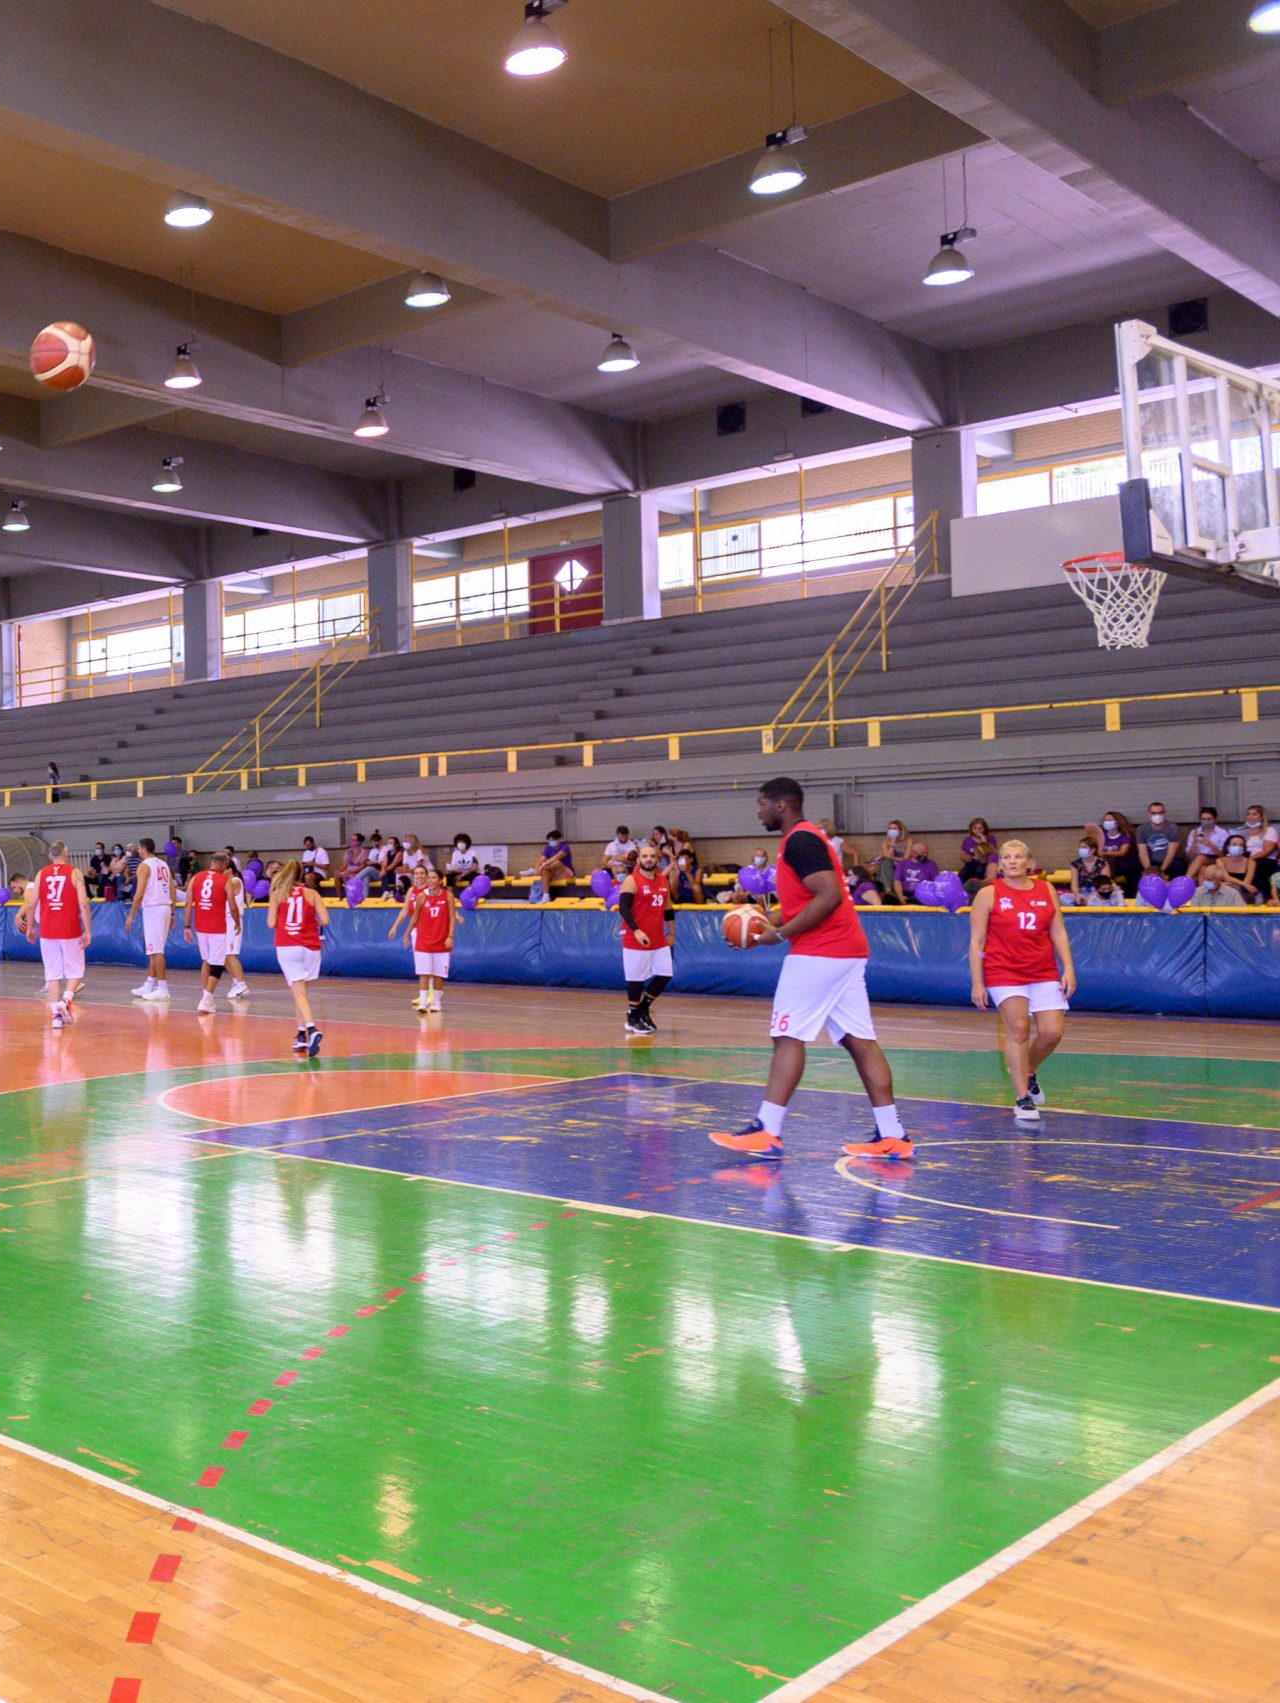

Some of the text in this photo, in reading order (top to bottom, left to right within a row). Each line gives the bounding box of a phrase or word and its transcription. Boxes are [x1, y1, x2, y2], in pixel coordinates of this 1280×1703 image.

[46, 875, 67, 900] 37
[200, 878, 214, 899] 8
[651, 894, 664, 907] 29
[429, 907, 440, 918] 17
[1017, 911, 1036, 930] 12
